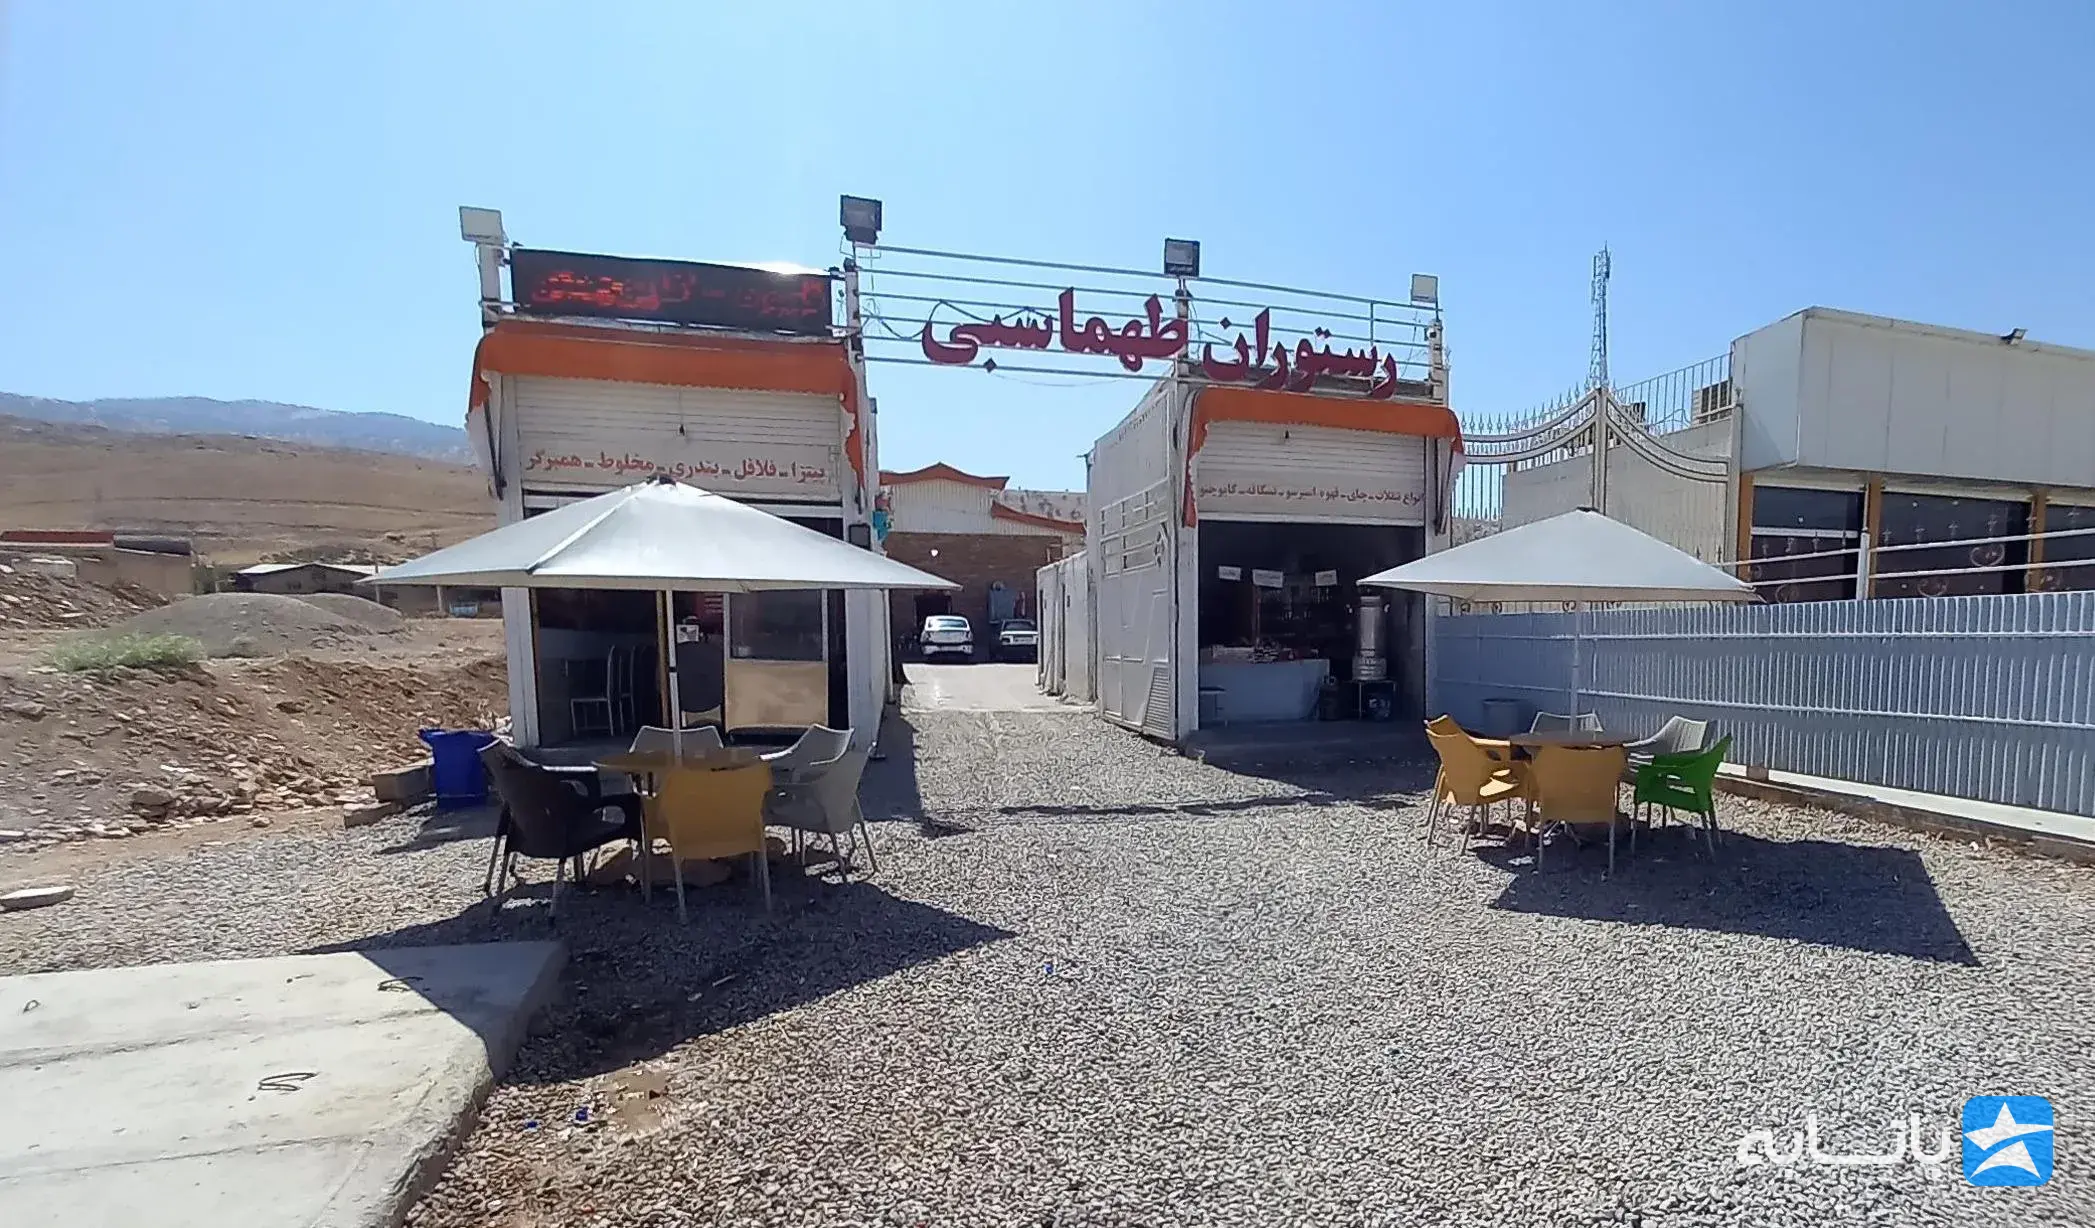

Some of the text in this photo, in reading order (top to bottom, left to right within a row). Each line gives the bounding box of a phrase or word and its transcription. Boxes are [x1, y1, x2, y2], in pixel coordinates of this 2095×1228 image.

[922, 287, 1188, 372] طهماسبی
[1203, 307, 1397, 398] رستوران
[526, 449, 582, 473] همبرگر
[597, 451, 654, 475] مخلوط
[668, 458, 718, 480] بندری
[734, 456, 776, 480] فلافل
